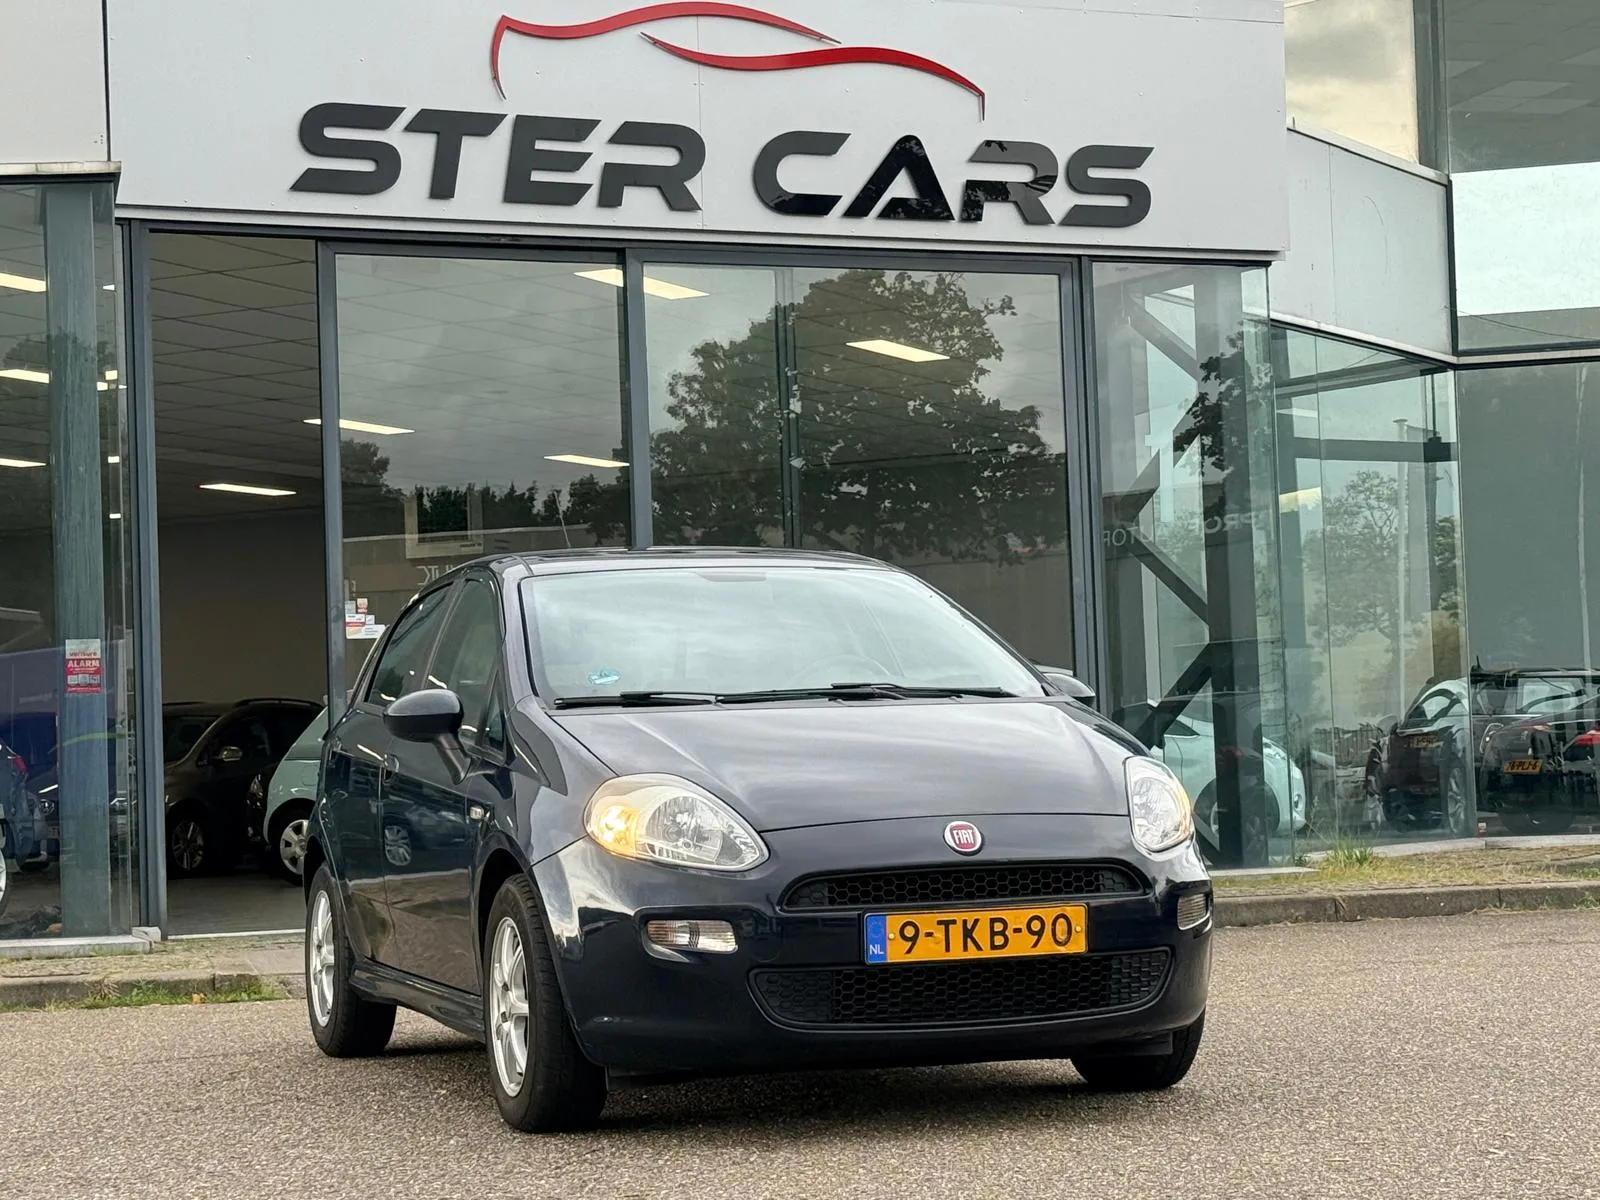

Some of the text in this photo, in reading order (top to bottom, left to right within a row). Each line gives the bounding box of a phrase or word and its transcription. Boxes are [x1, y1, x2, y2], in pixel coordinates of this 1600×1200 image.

[288, 102, 1155, 228] STER CARS
[67, 659, 100, 668] ALARM
[952, 829, 975, 845] FIAT
[869, 912, 1073, 955] NL 9-TKB-90
